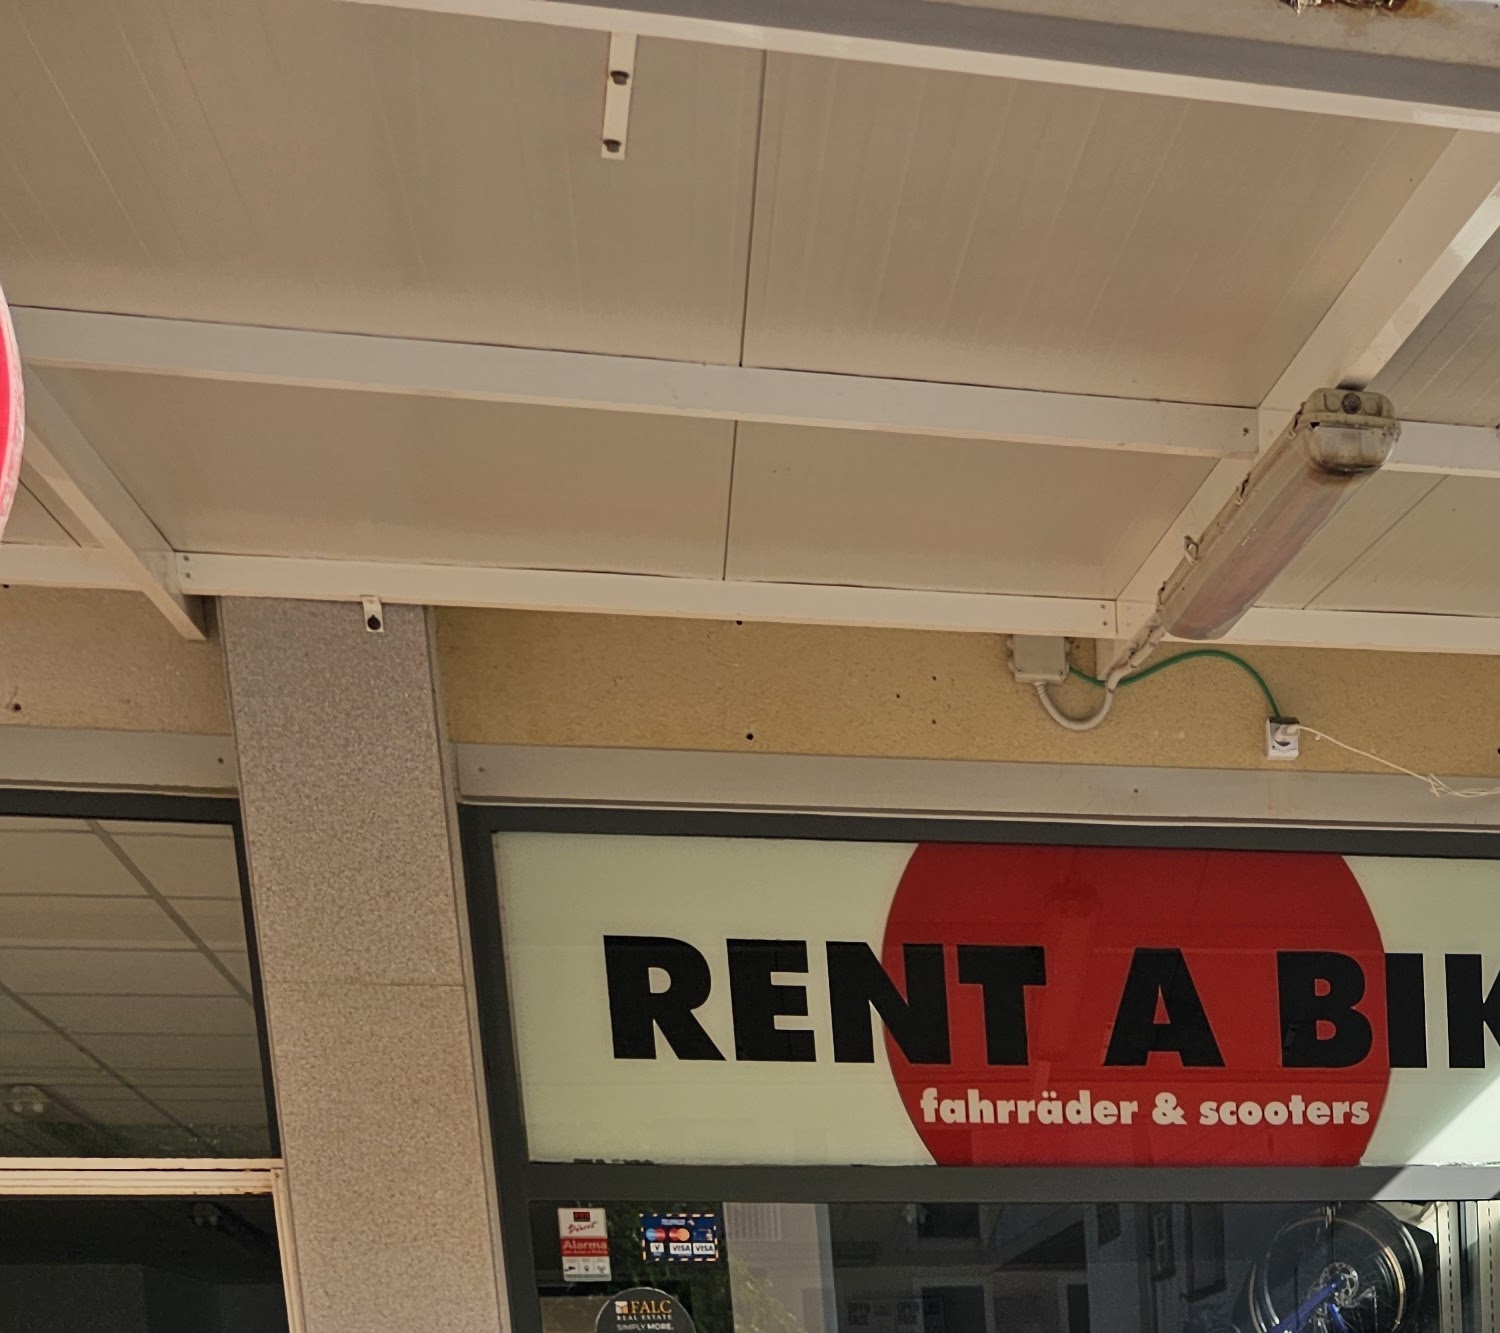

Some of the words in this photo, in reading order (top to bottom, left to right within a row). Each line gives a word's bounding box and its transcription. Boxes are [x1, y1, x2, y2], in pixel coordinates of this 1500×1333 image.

[603, 935, 1047, 1067] RENT
[1103, 947, 1226, 1067] A
[920, 1088, 1138, 1125] fahrräder
[1152, 1092, 1187, 1125] &
[1200, 1095, 1369, 1125] scooters
[563, 1239, 608, 1250] Alarma
[631, 1300, 672, 1314] FALC
[617, 1323, 645, 1331] SIMPLY
